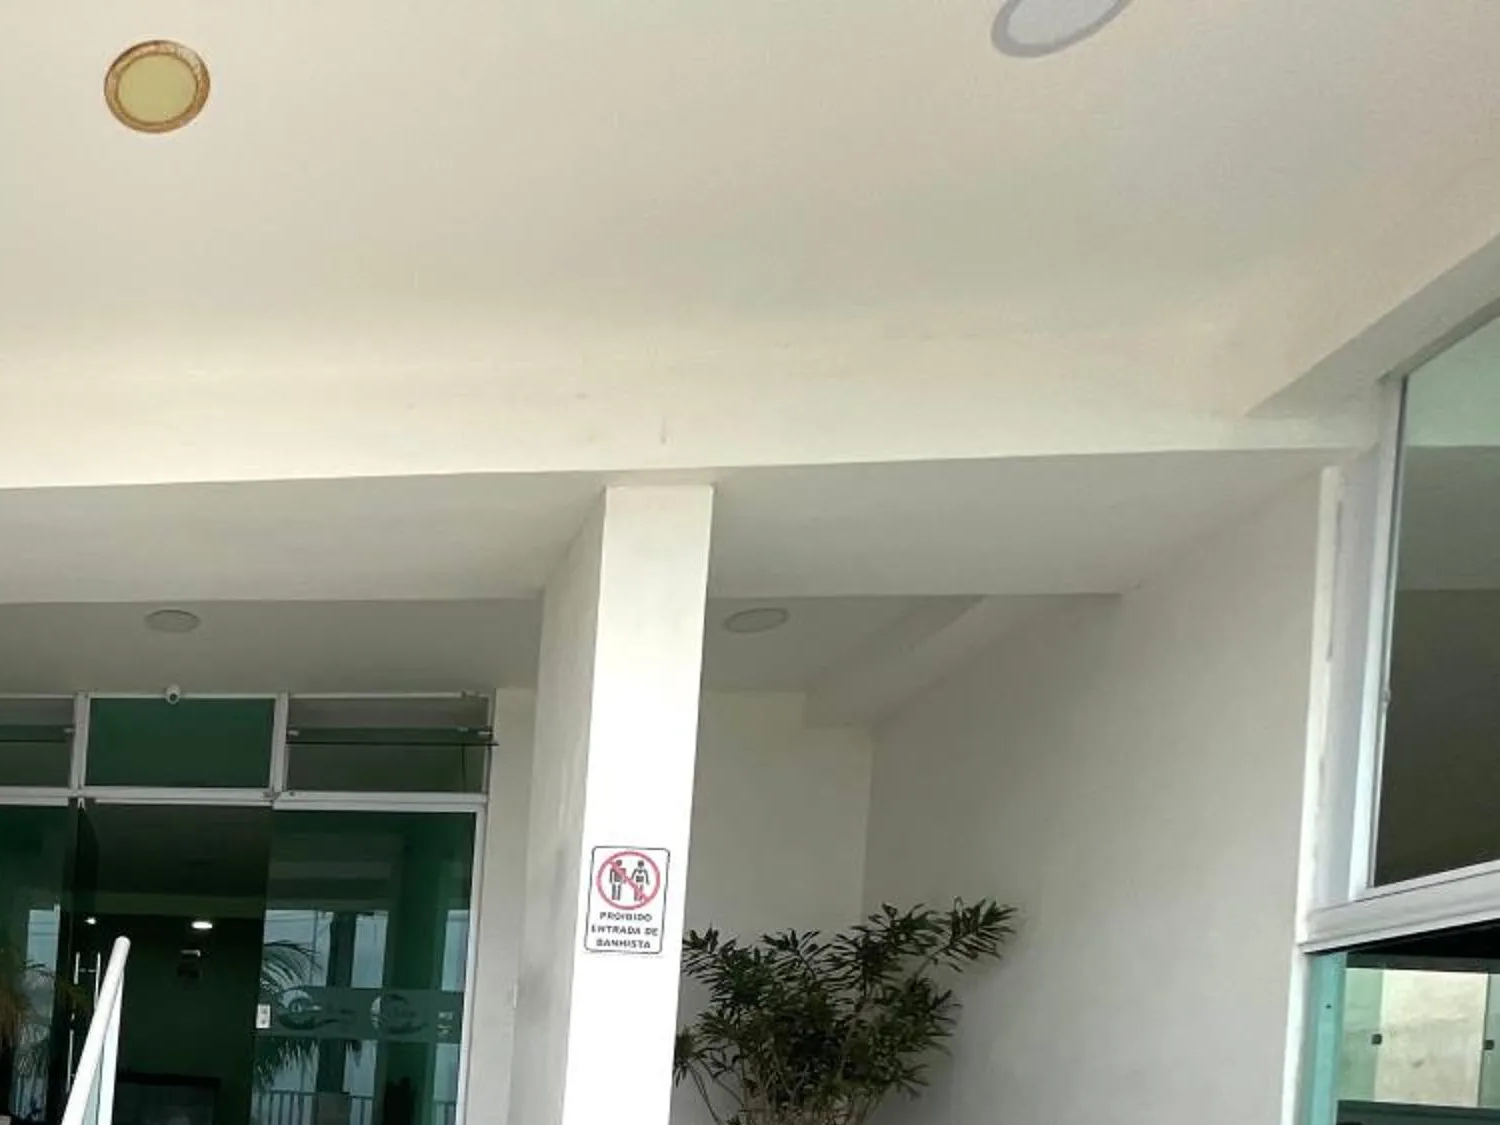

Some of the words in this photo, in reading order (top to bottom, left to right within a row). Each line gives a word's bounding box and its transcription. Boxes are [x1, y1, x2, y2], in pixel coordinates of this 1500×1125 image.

[599, 911, 653, 922] PROIBIDO
[591, 924, 641, 935] ENTRADA
[644, 927, 659, 937] DE
[596, 939, 651, 949] BANHISTA
